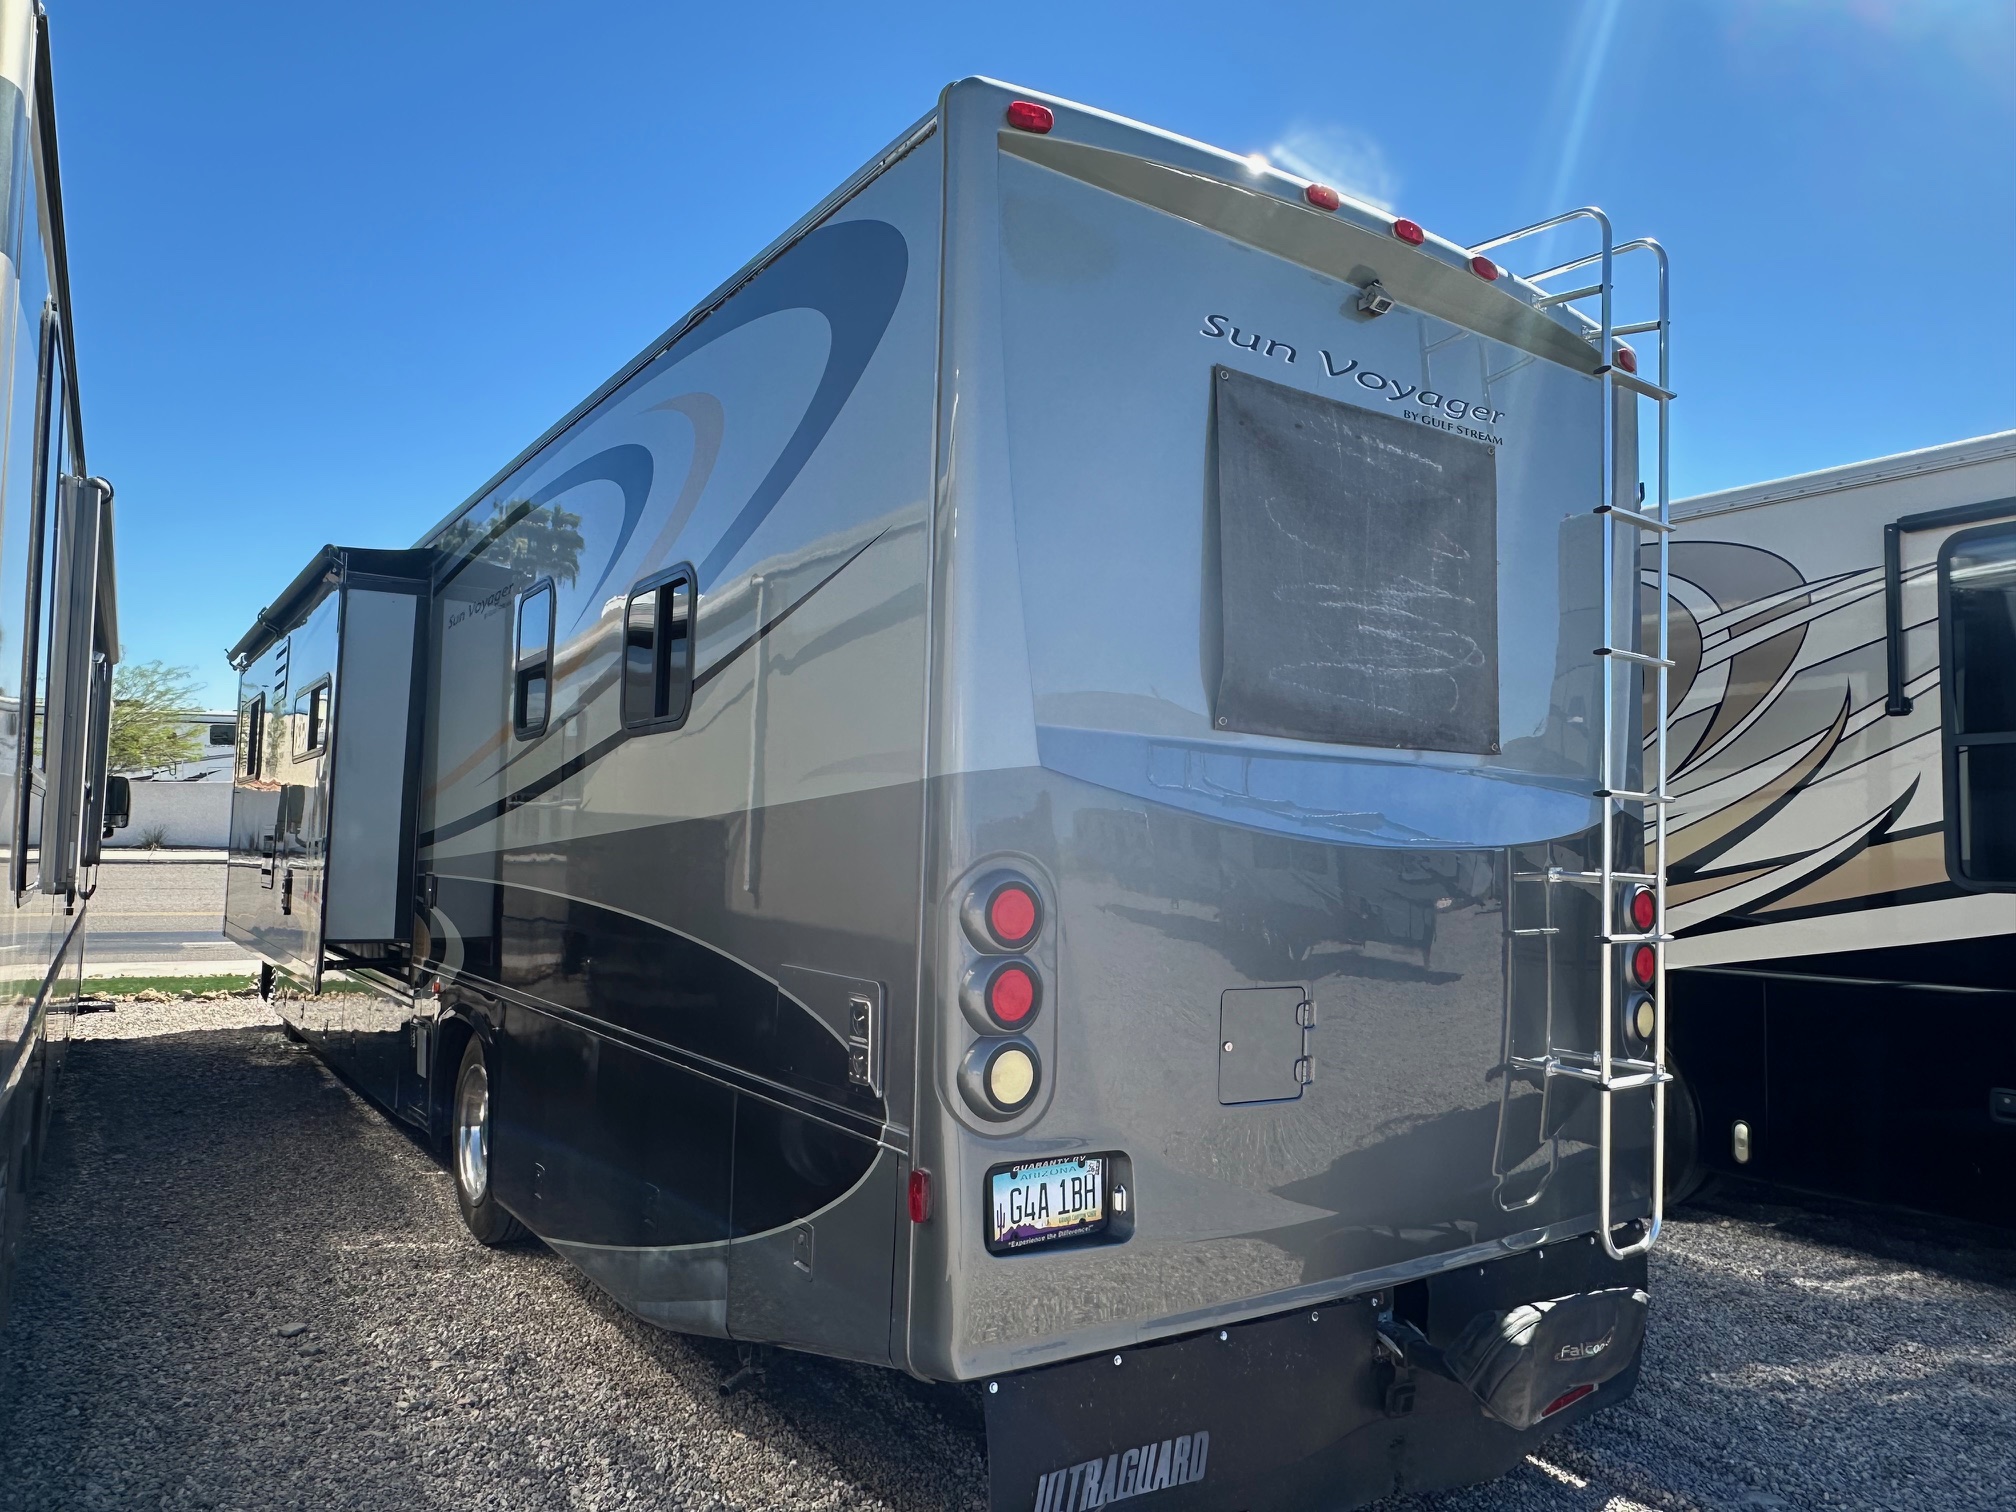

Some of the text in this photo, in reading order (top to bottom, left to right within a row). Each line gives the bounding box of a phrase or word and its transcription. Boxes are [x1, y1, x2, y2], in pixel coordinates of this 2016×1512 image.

[1200, 314, 1505, 424] Sun Voyager
[1403, 409, 1503, 445] BY GULF STREAM
[448, 611, 466, 630] Sun
[468, 582, 514, 618] Voyager
[1020, 1165, 1077, 1181] ARIZONA
[1010, 1174, 1096, 1224] G4A 1BH
[1034, 1430, 1210, 1512] ULTRAGUARD
